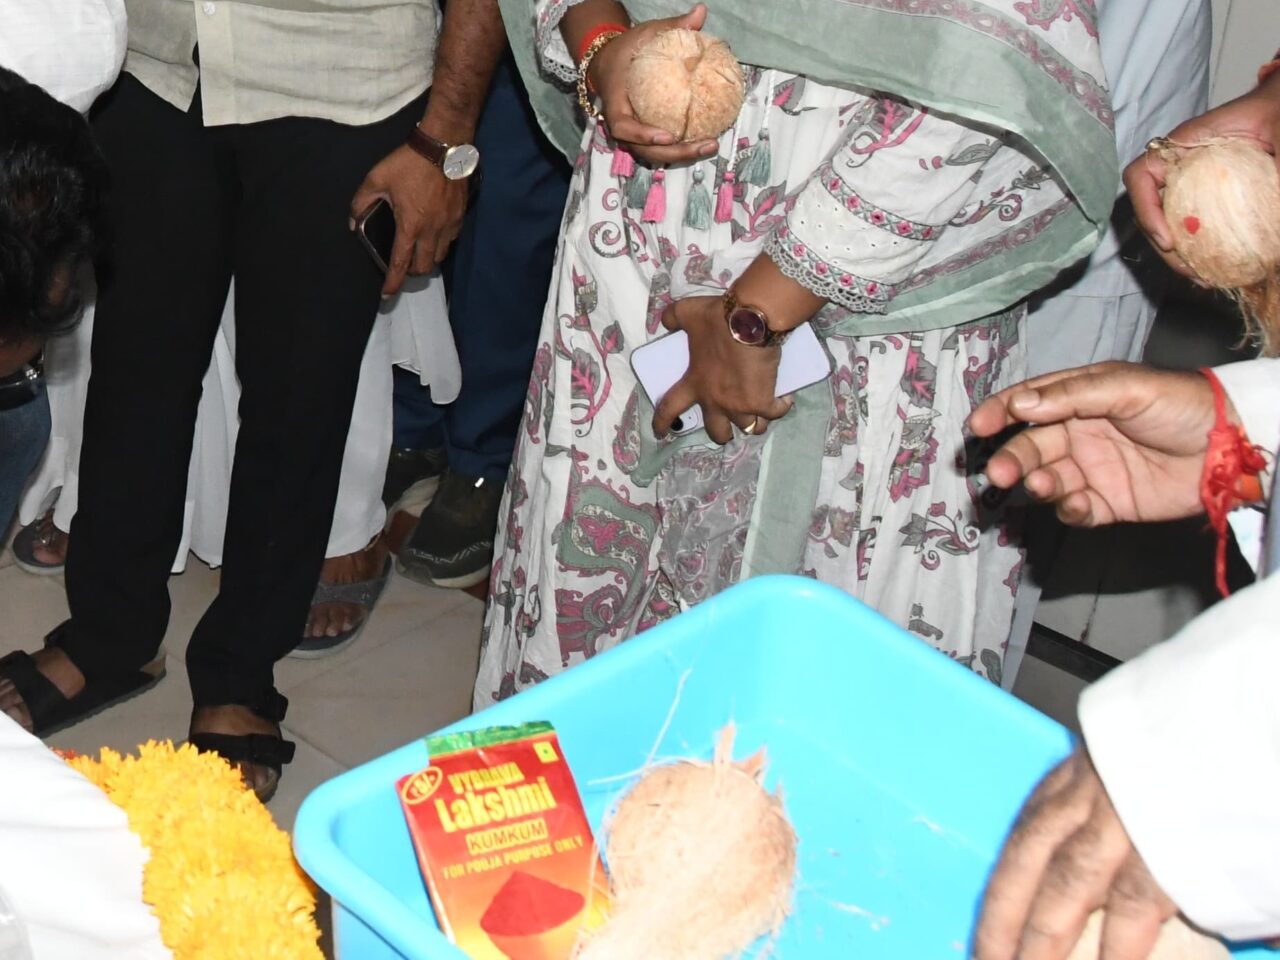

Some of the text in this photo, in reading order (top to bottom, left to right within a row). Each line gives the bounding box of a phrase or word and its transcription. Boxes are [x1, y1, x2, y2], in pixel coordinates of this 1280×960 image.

[435, 776, 557, 832] Lakshmi
[443, 835, 583, 879] FOR POOJA PURPOSE ONLY
[469, 820, 546, 852] KUMKUM
